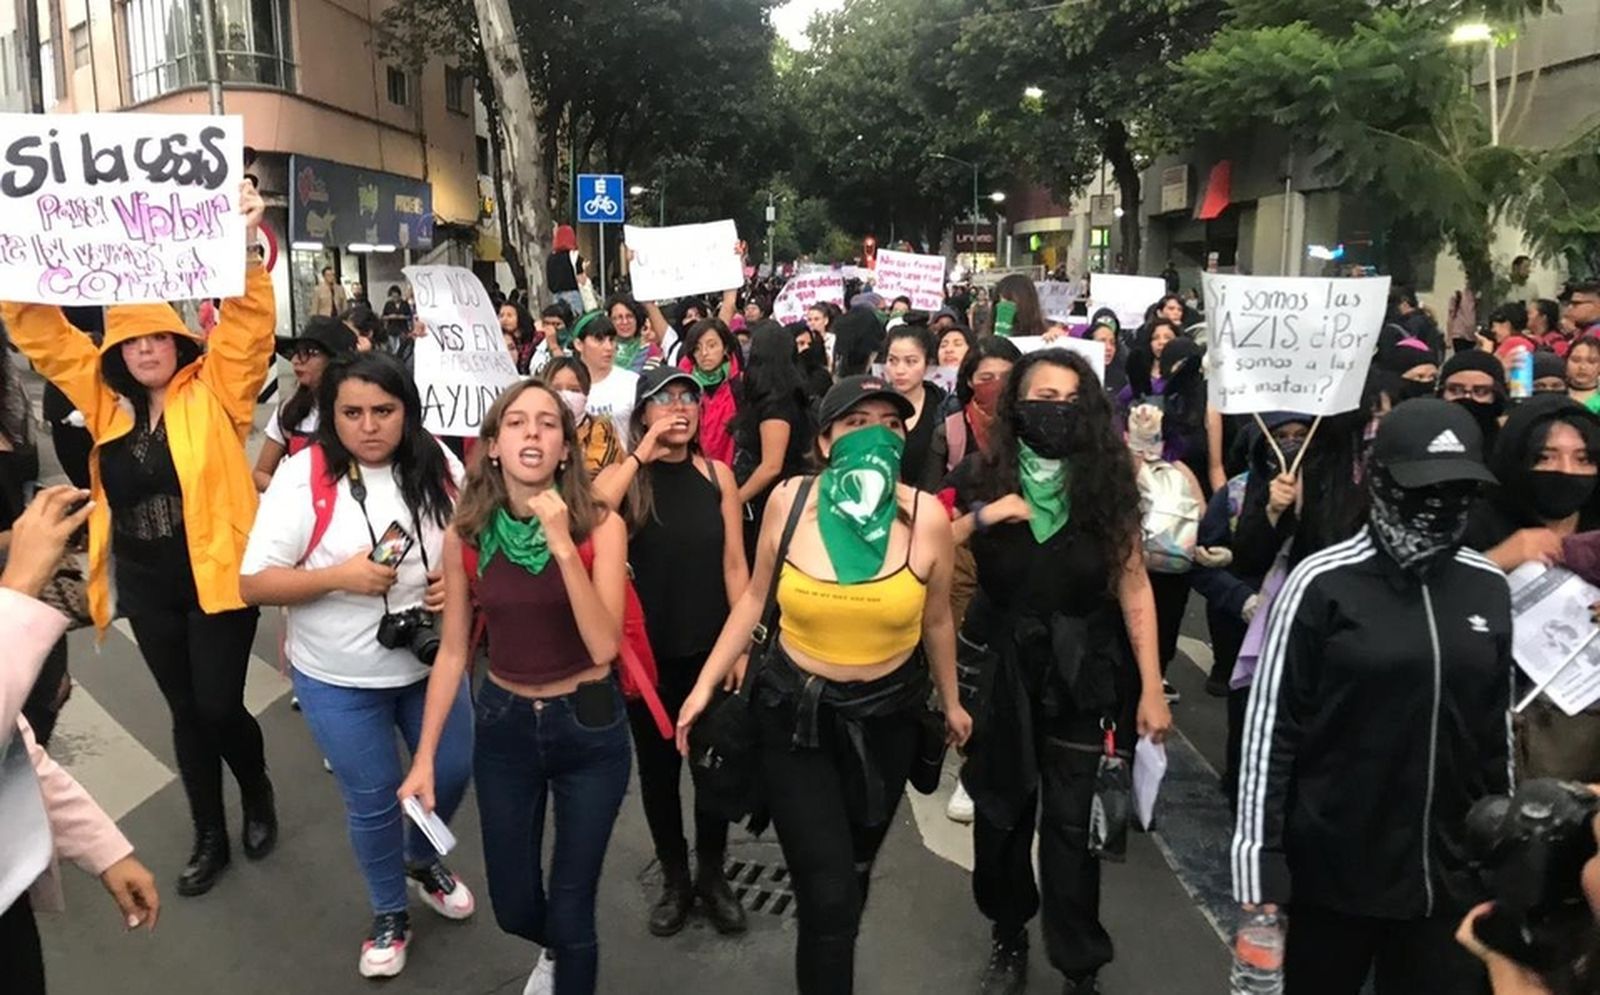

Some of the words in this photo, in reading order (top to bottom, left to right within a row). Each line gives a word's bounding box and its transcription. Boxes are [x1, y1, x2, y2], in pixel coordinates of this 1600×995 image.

[1, 128, 67, 198] Si
[80, 132, 129, 186] la
[415, 272, 438, 308] SI
[445, 270, 481, 308] NOS
[1207, 279, 1227, 309] Si
[1242, 288, 1309, 311] somos
[1325, 281, 1361, 309] las
[427, 323, 465, 353] VES
[472, 323, 499, 352] EN
[1306, 361, 1316, 370] a
